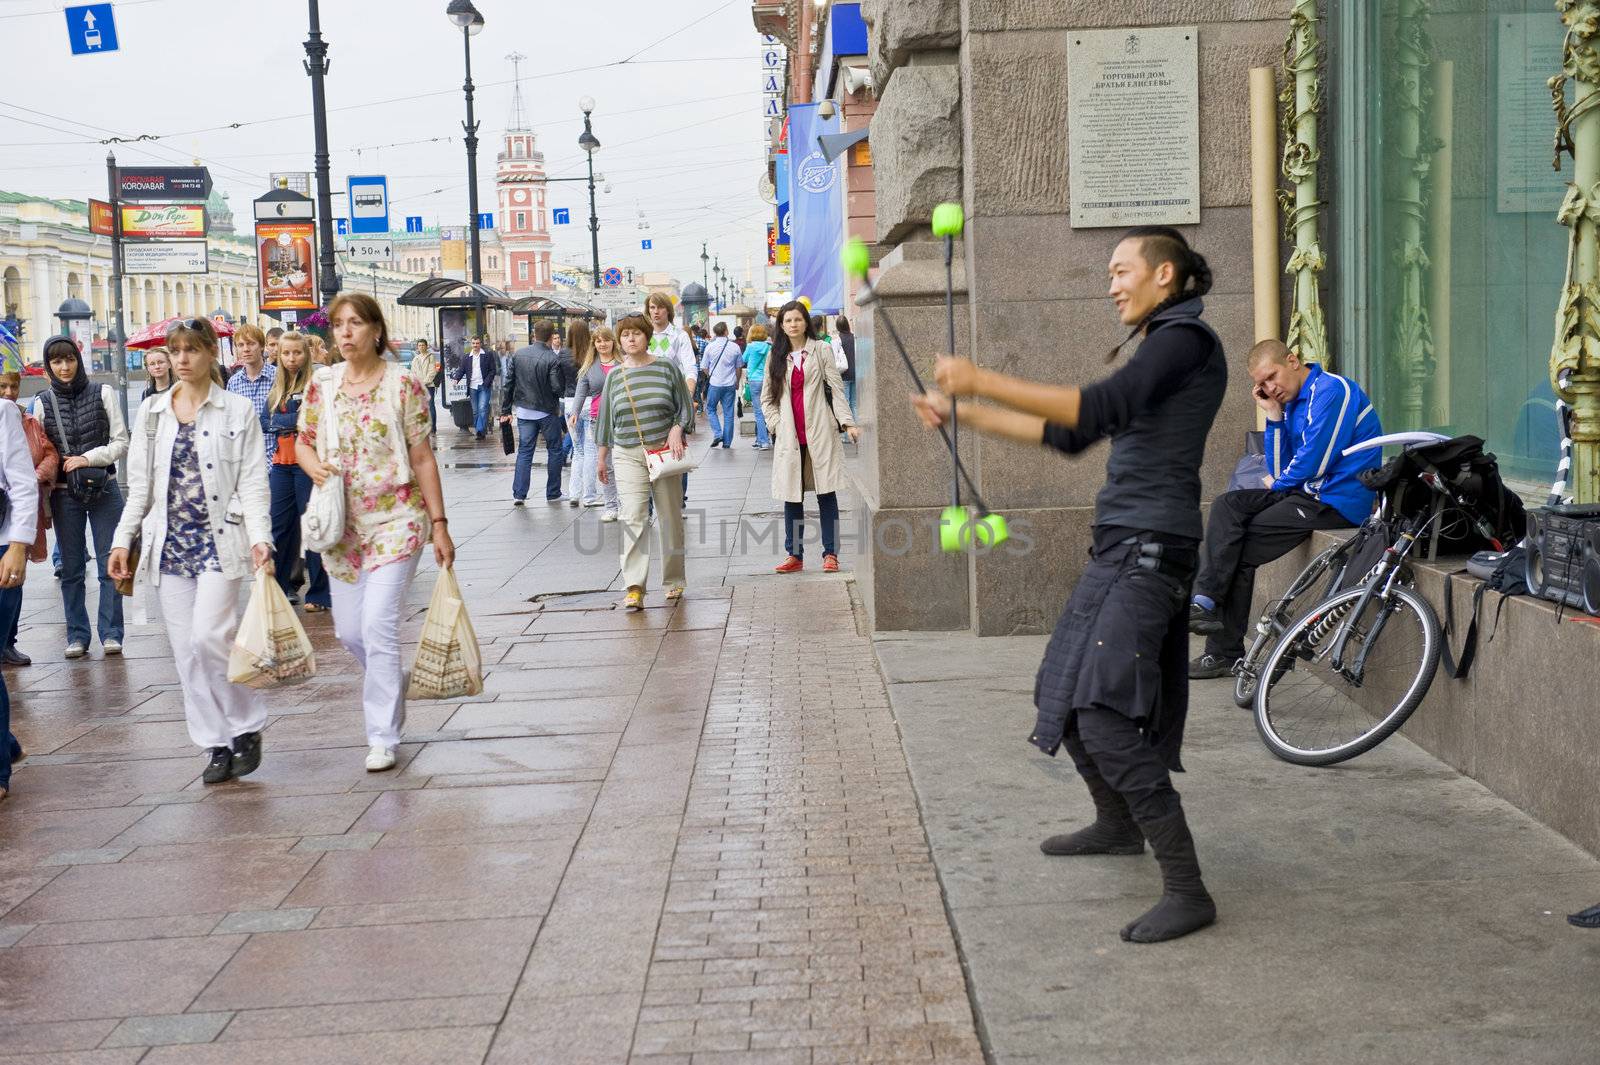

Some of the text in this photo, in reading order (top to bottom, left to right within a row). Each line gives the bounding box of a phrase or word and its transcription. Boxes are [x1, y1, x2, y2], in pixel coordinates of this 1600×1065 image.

[1102, 71, 1165, 80] ТОРГОВЫЙ ДОМ
[121, 182, 165, 190] KOROVABAR
[133, 206, 189, 223] Don Pepe
